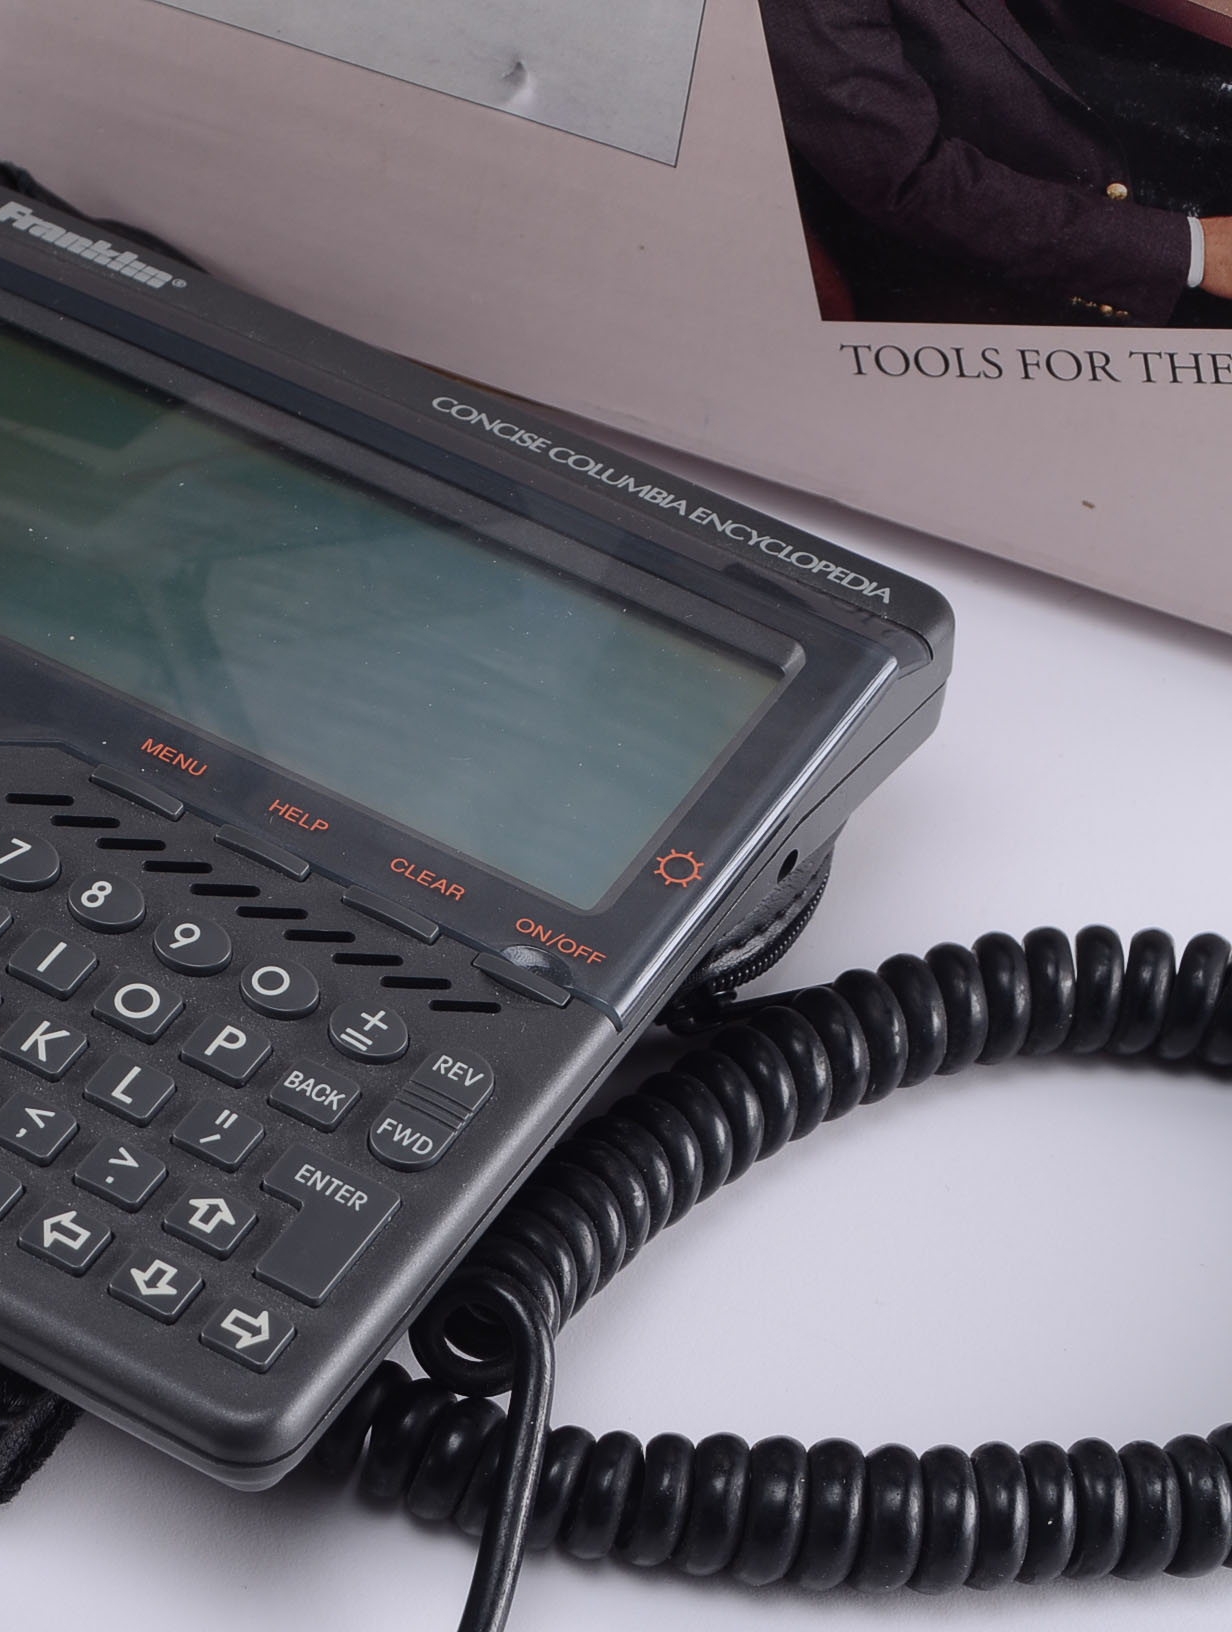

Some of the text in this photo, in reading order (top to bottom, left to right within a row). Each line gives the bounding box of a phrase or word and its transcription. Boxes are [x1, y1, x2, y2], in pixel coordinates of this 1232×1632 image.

[839, 344, 1232, 385] TOOLS FOR THE
[431, 396, 892, 604] CONCISE COLUMBIA ENCYCLOPEDIA
[141, 737, 208, 776] MENU
[268, 799, 329, 831] HELP
[80, 880, 113, 908] 8
[391, 857, 465, 901] CLEAR
[169, 923, 201, 949] 9
[516, 917, 606, 964] ON/OFF
[36, 941, 67, 973] I
[114, 983, 161, 1019] O
[20, 1020, 70, 1062] K
[204, 1025, 247, 1056] P
[111, 1066, 142, 1104] L
[432, 1054, 484, 1087] REV
[283, 1070, 346, 1110] BACK
[376, 1117, 433, 1155] FWD
[294, 1163, 368, 1211] ENTER
